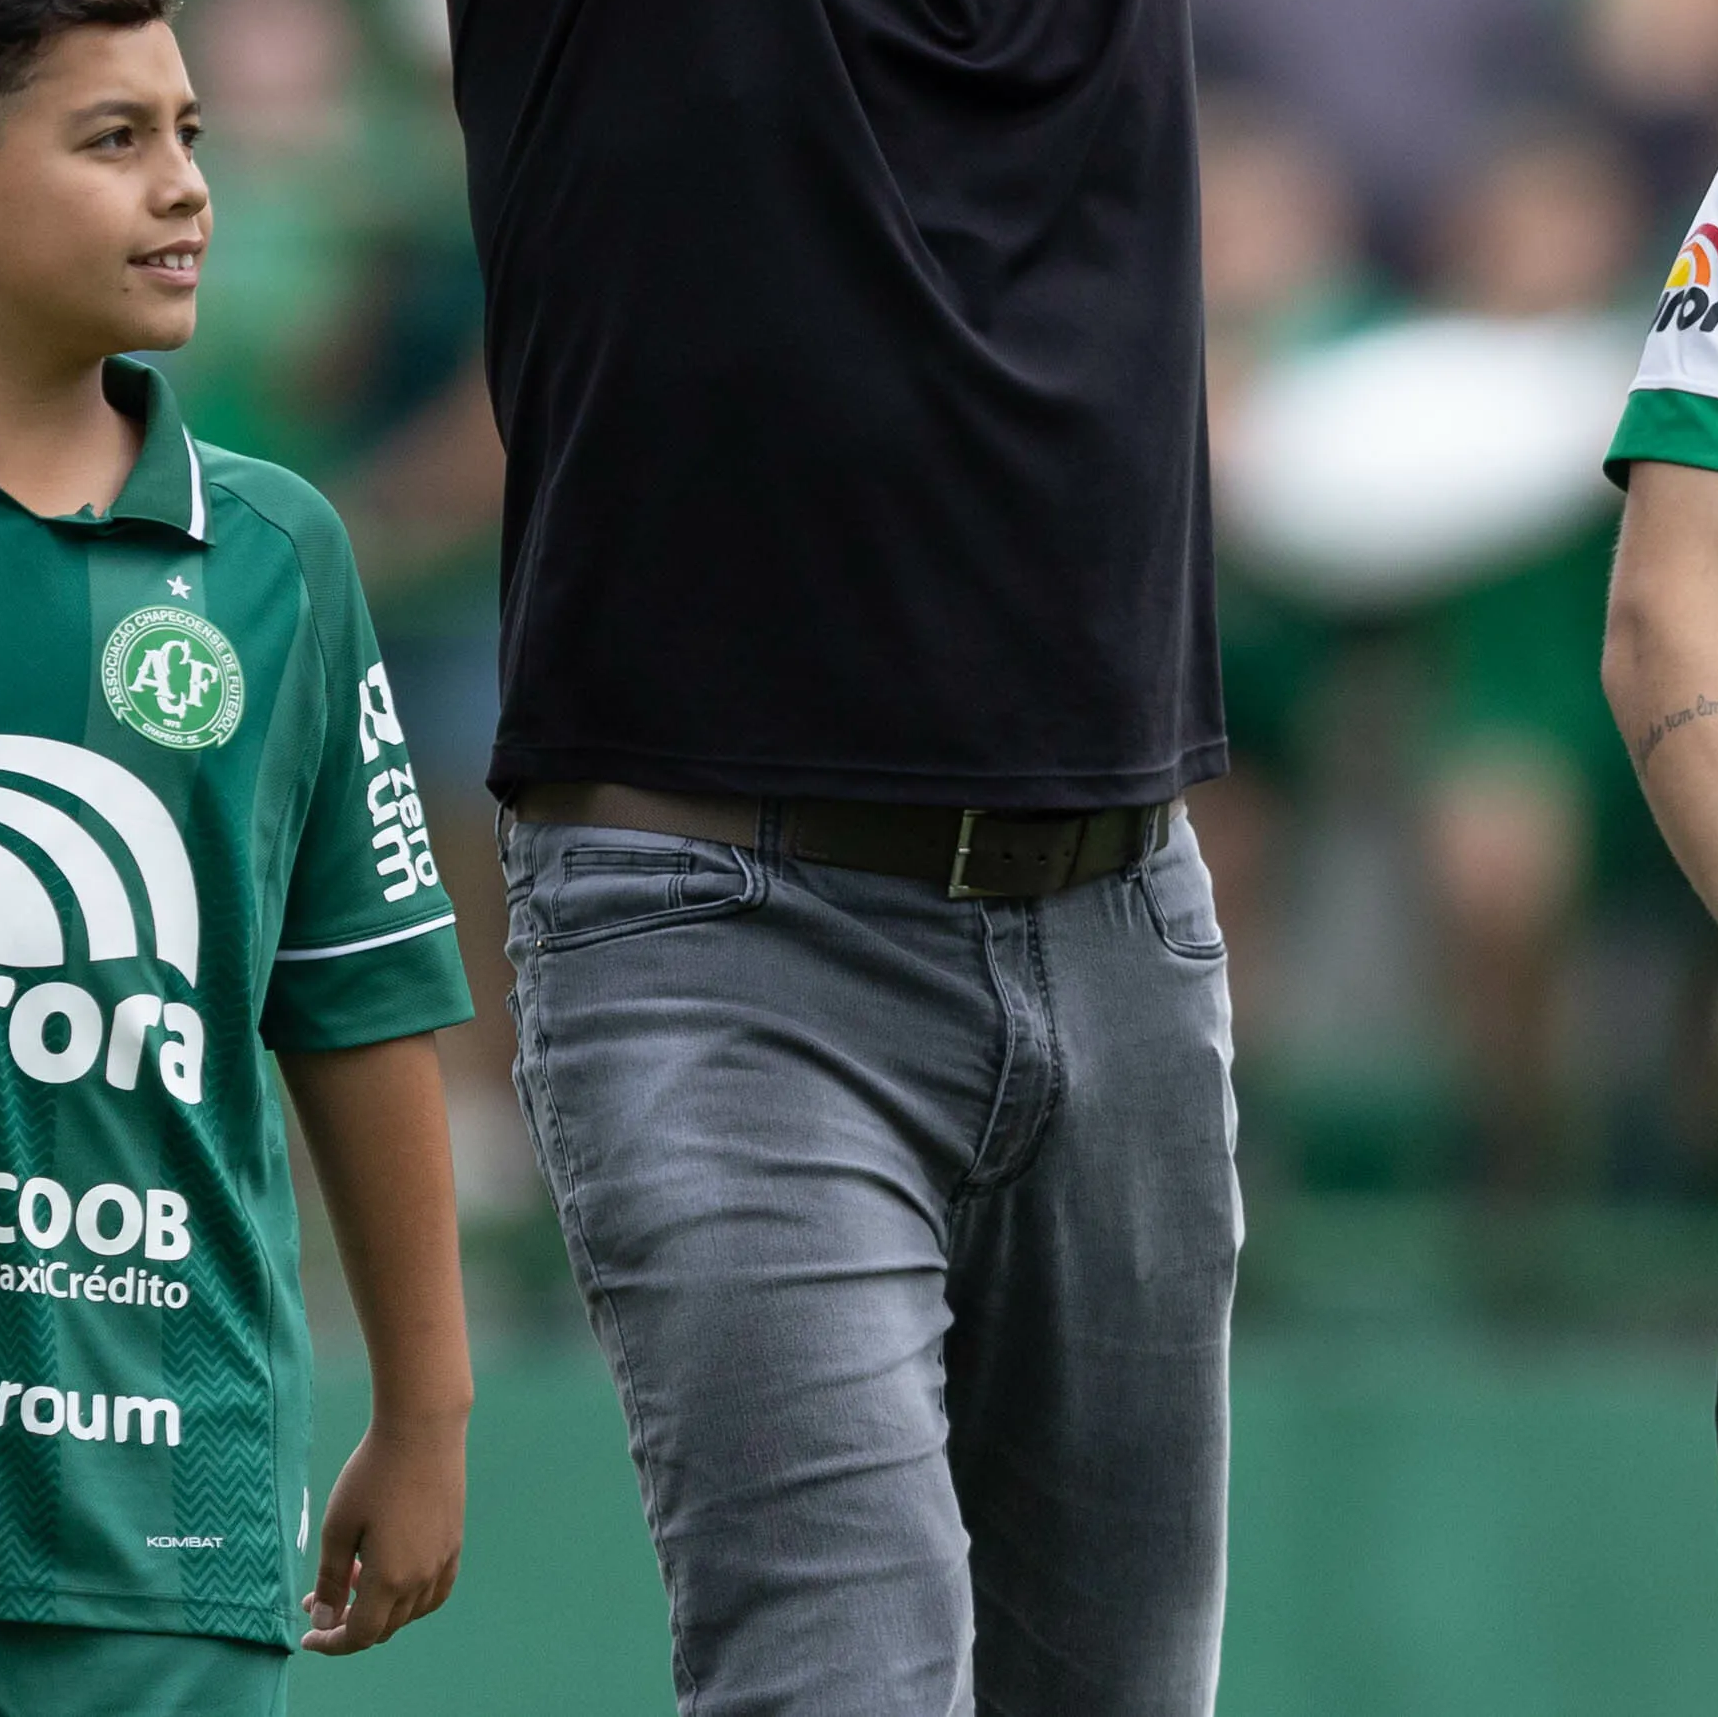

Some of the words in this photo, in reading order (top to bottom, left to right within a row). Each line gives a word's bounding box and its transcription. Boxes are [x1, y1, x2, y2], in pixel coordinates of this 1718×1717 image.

[134, 610, 225, 652] CHAPECOENSE
[128, 638, 219, 719] ACF
[221, 653, 234, 672] DE
[218, 675, 240, 732] FUTEBOL
[146, 1536, 223, 1548] KOMBAT
